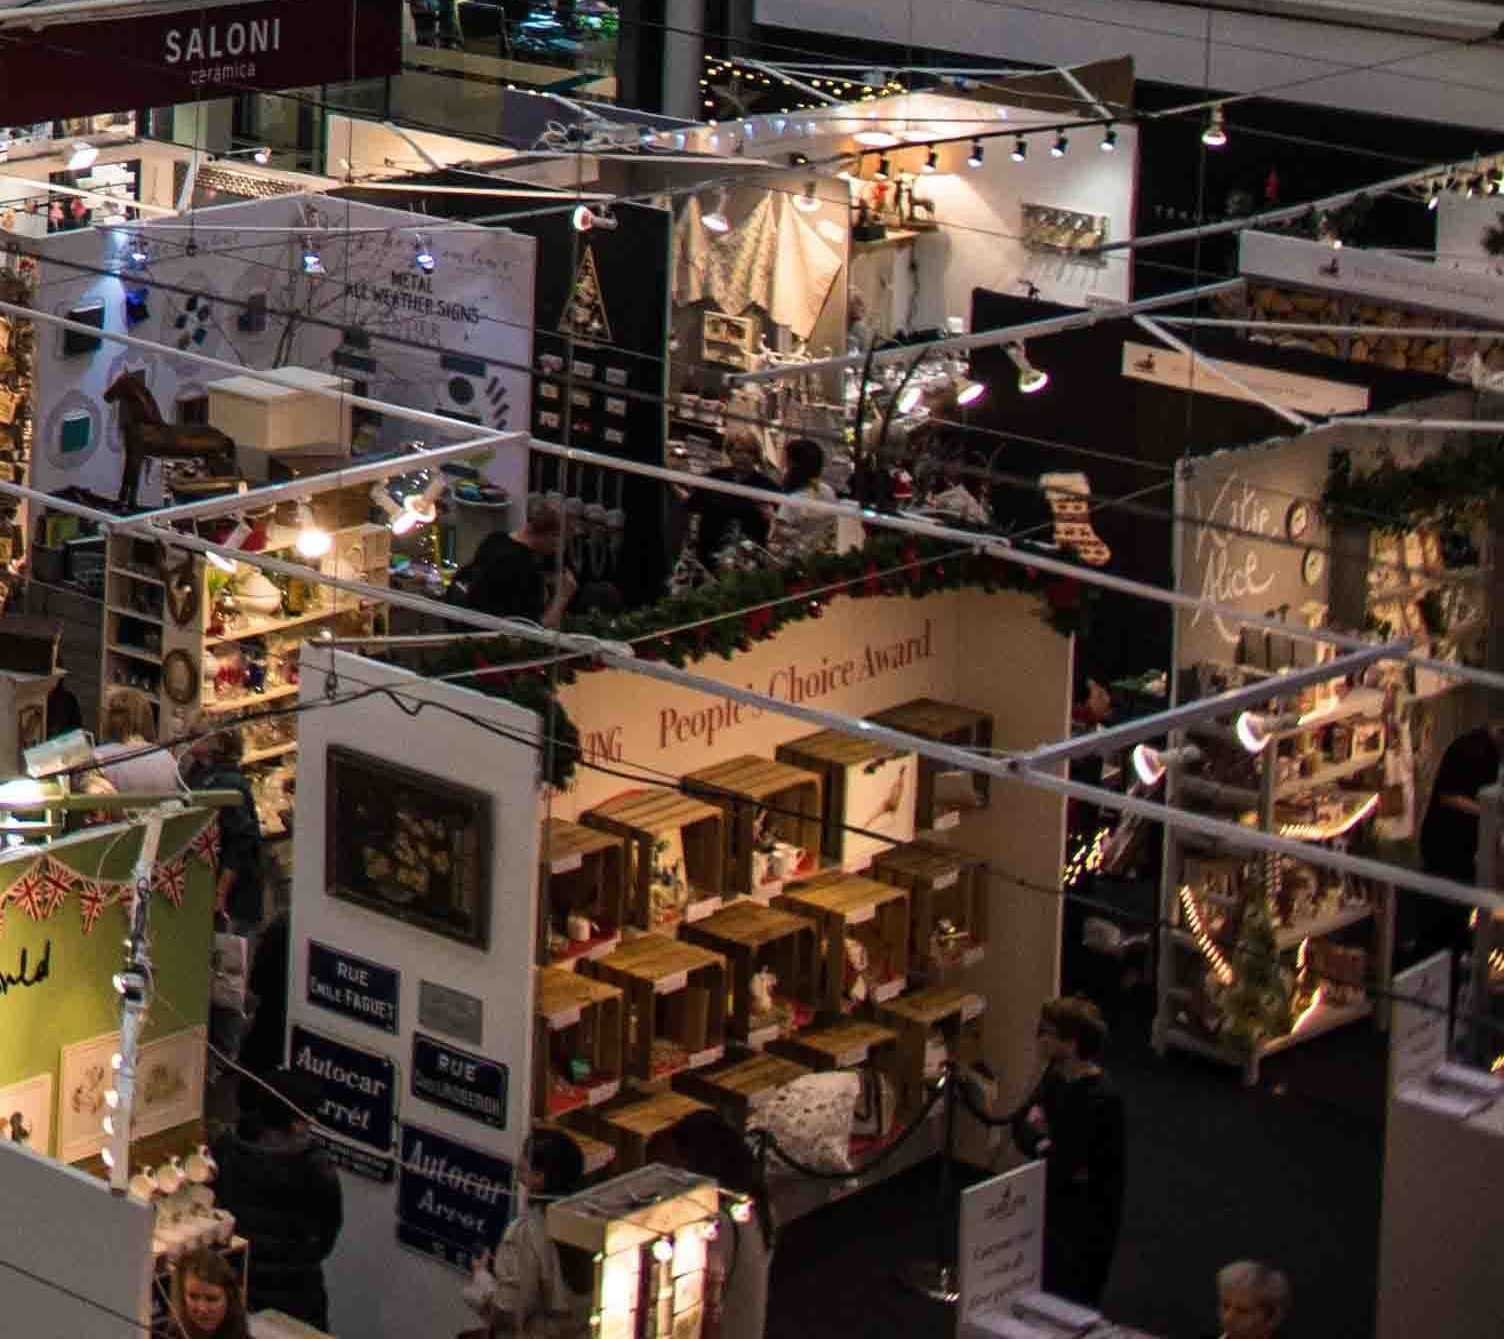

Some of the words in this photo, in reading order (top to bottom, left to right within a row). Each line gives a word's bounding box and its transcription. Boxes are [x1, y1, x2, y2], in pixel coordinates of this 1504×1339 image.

[165, 18, 281, 64] SALONI
[769, 657, 854, 706] Choice
[856, 619, 938, 681] Award
[337, 961, 369, 988] RUE
[295, 1045, 387, 1097] Autocar
[437, 1052, 478, 1083] RUE
[409, 1140, 505, 1205] Autocar
